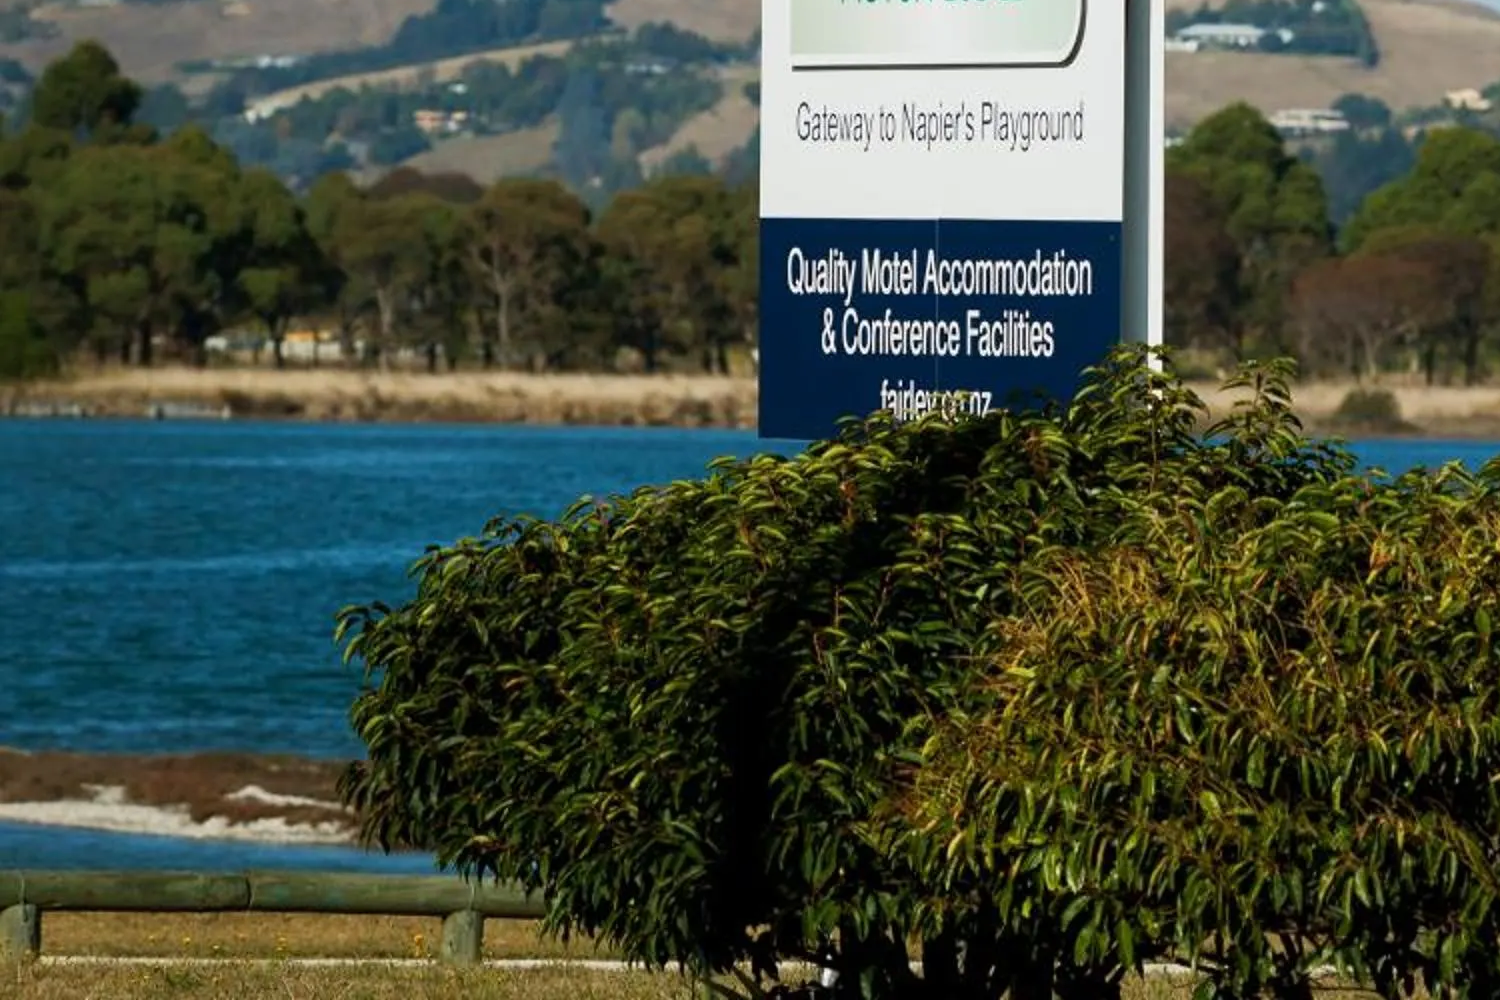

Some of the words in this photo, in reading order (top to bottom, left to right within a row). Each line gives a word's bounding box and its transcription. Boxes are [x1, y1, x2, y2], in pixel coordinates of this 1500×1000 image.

[796, 102, 874, 151] Gateway
[879, 105, 896, 139] to
[901, 100, 976, 150] Napier's
[980, 100, 1084, 151] Playground
[787, 247, 857, 306] Quality
[861, 248, 917, 295] Motel
[922, 249, 1092, 296] Accommodation
[821, 307, 837, 354] &
[841, 308, 961, 356] Conference
[965, 309, 1055, 358] Facilities
